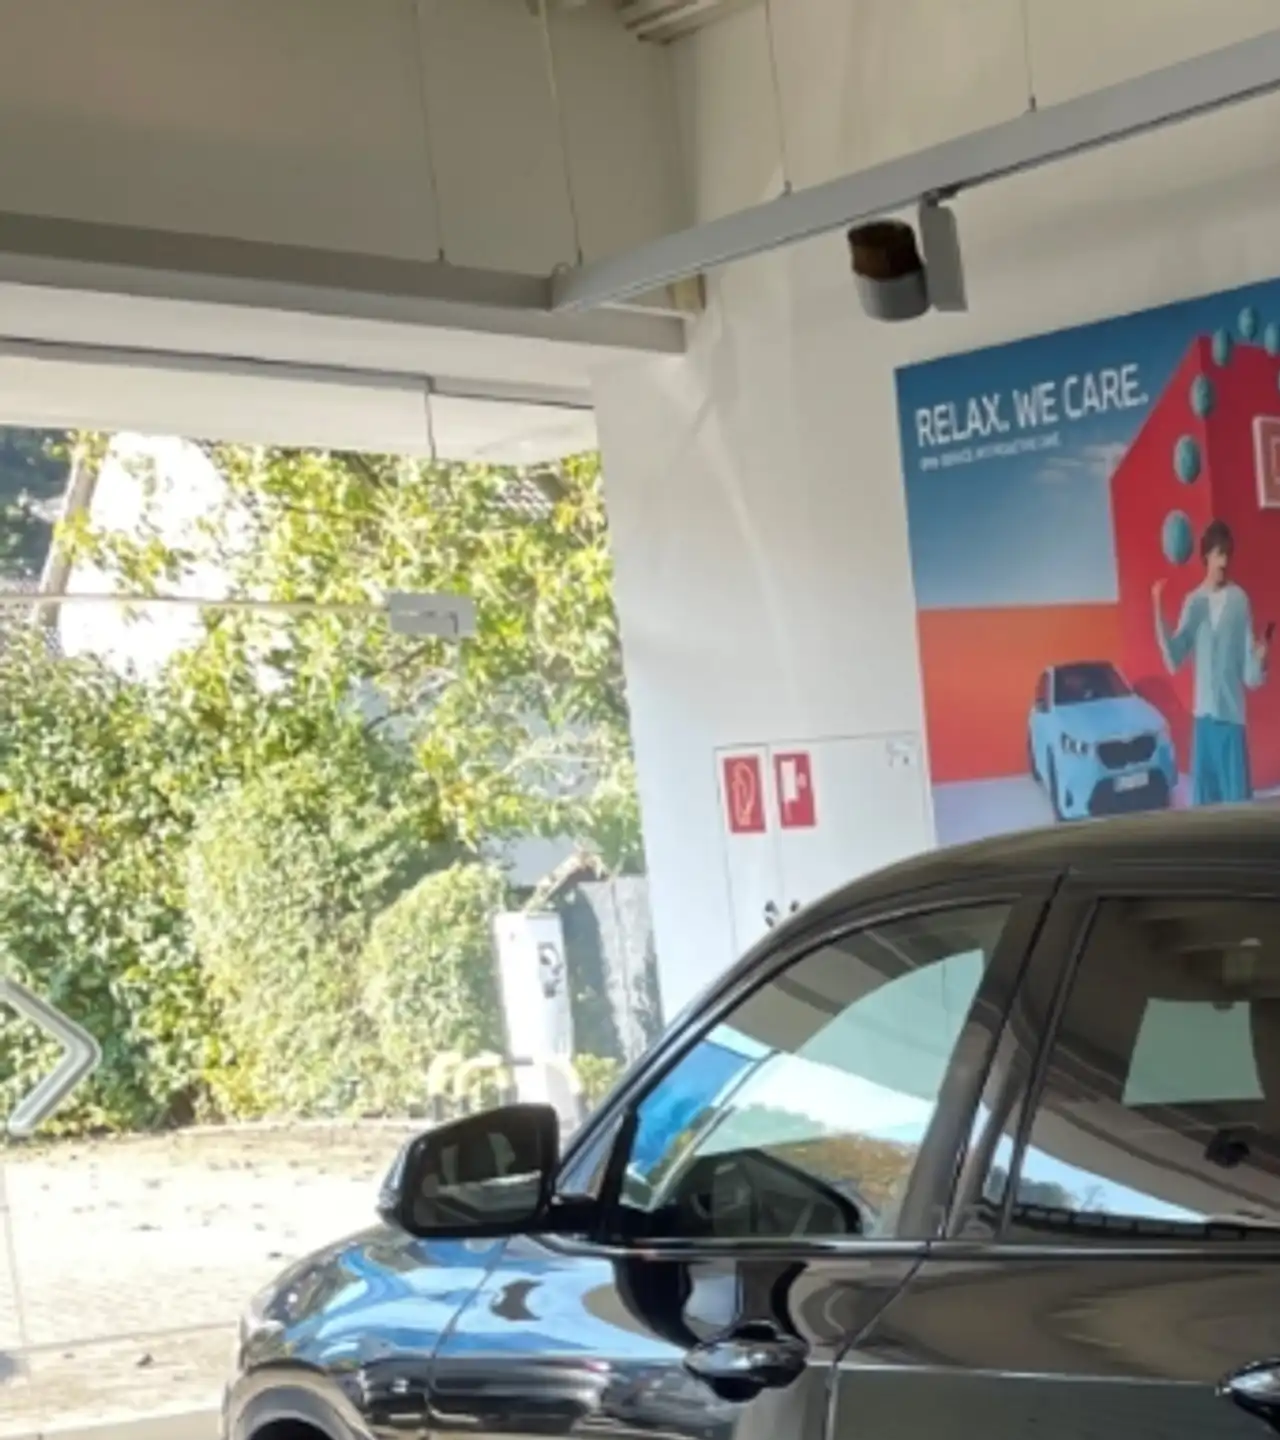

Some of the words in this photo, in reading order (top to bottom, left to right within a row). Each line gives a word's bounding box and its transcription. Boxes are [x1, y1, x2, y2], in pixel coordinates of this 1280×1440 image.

[915, 391, 1011, 448] RELAX.
[1012, 380, 1059, 429] WE
[1063, 362, 1150, 421] CARE.
